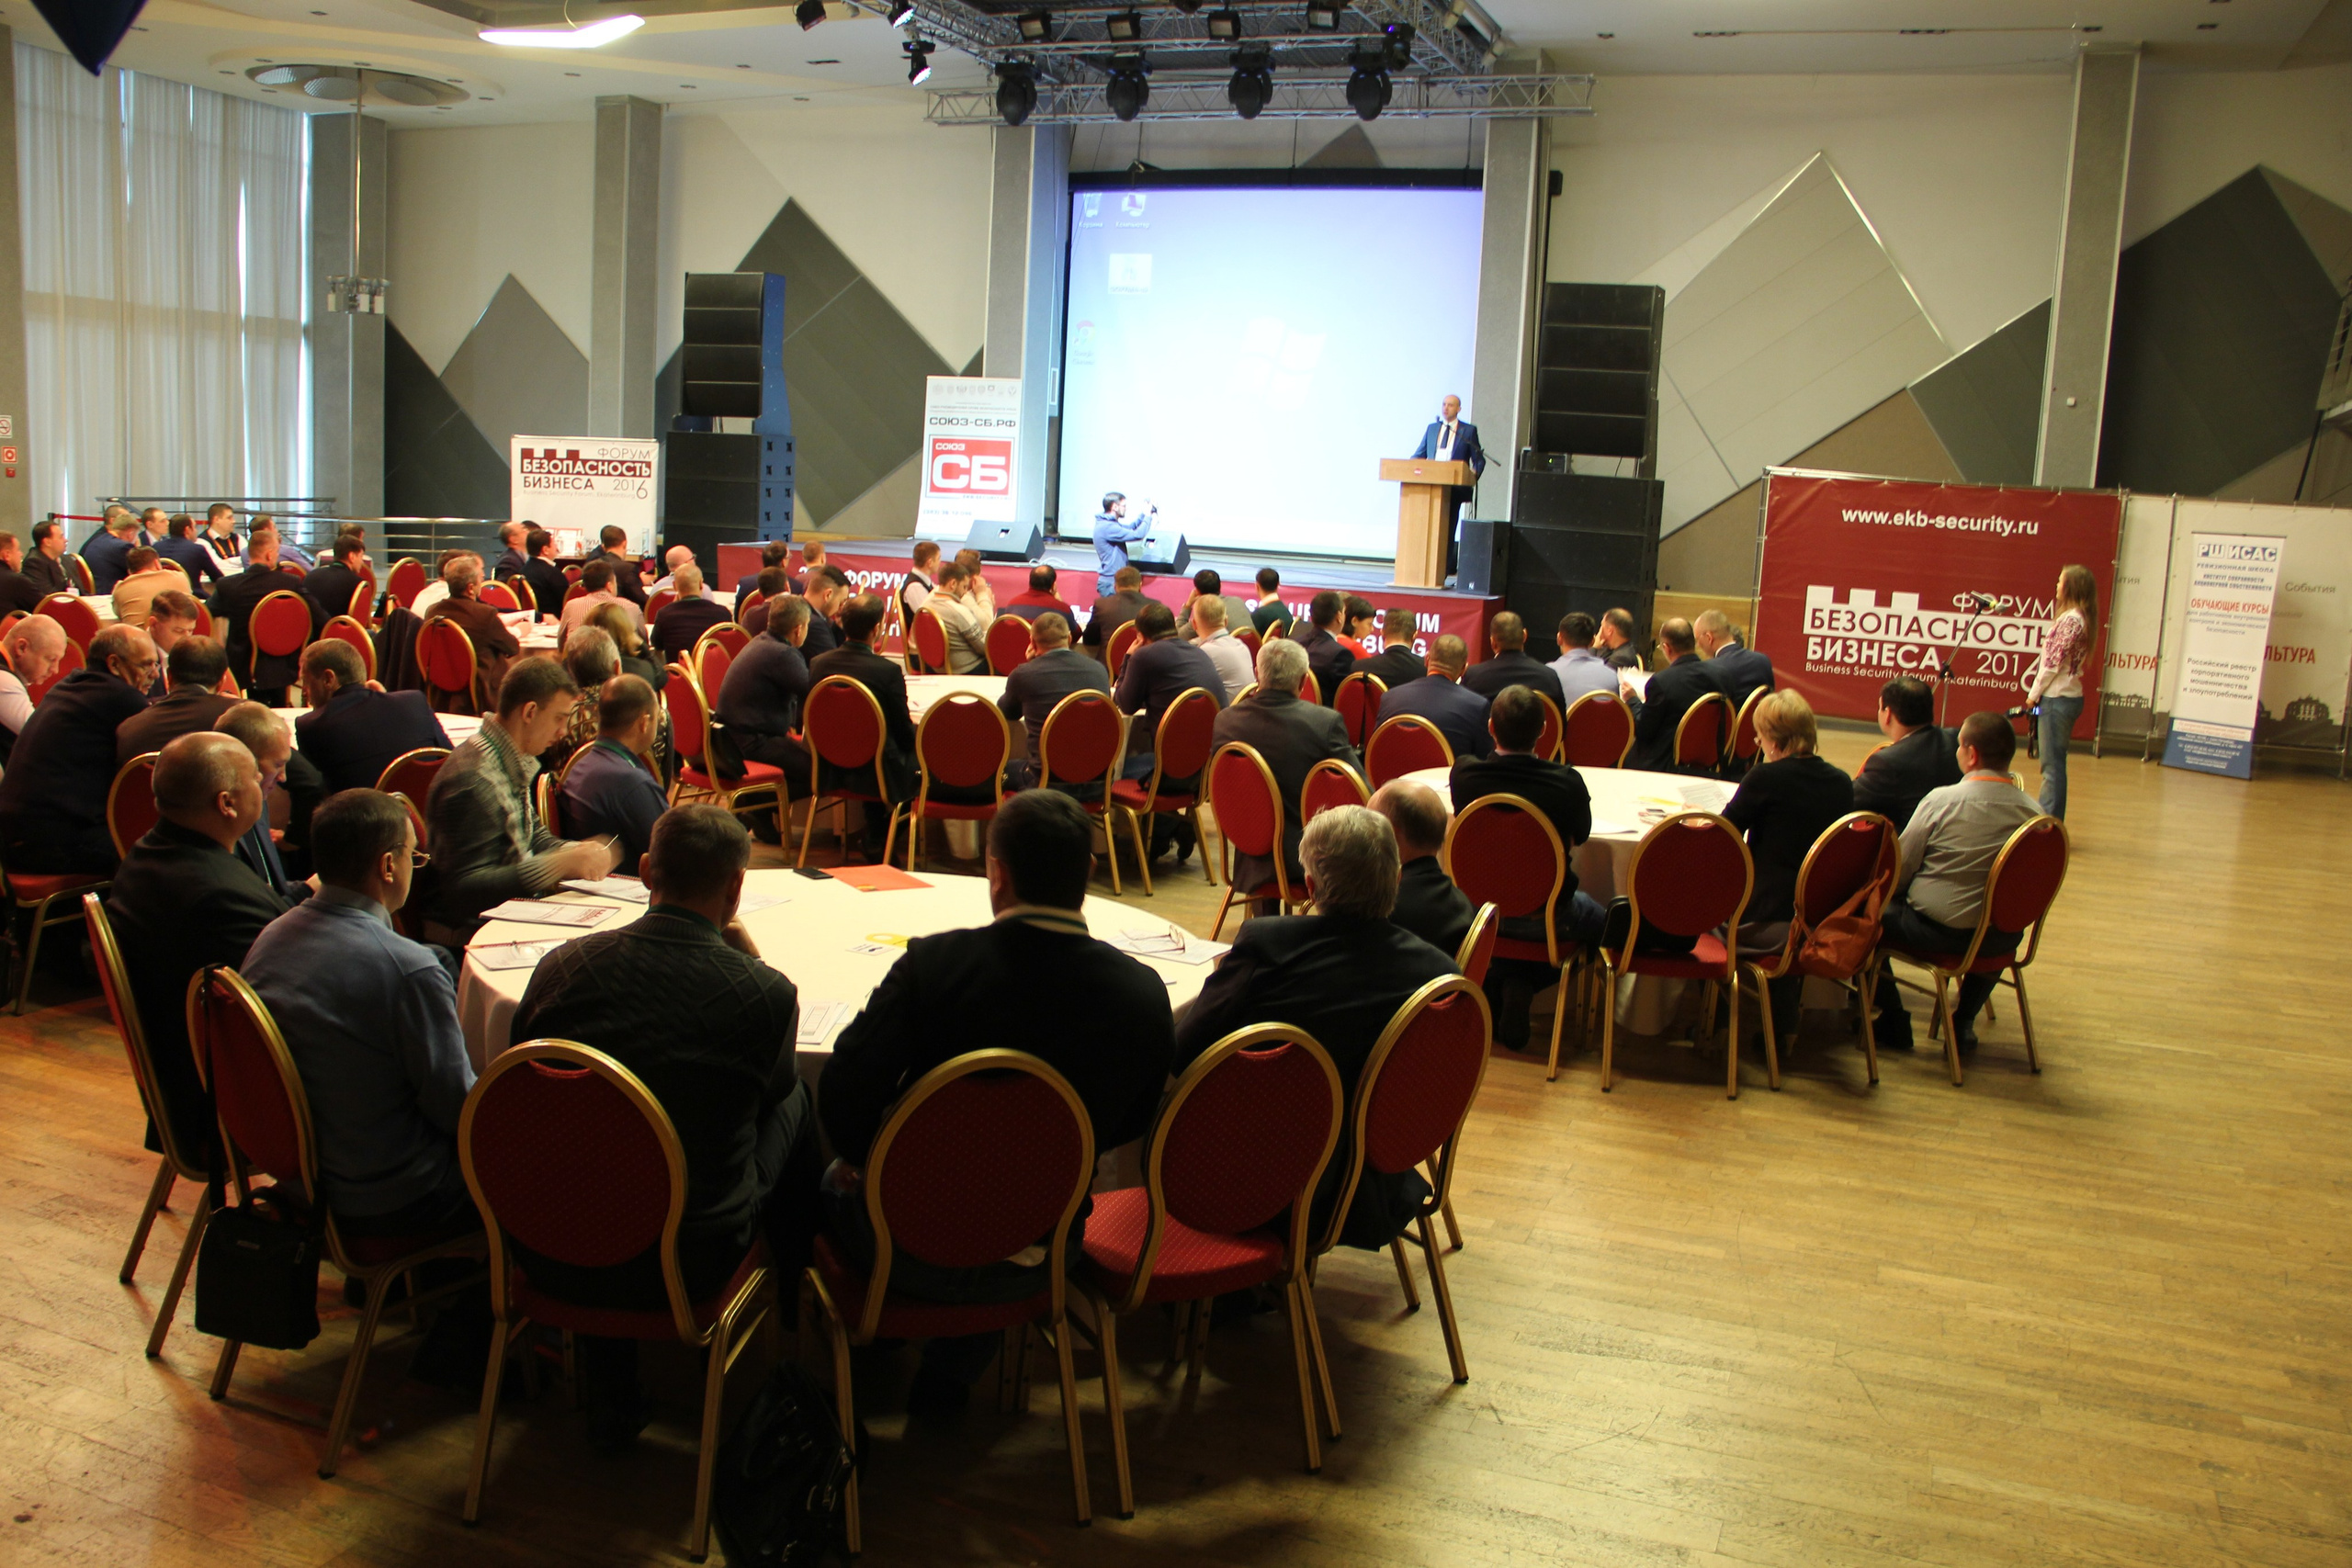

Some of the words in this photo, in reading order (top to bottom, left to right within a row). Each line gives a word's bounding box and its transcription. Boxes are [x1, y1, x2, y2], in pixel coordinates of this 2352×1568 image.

[929, 417, 1016, 427] СОЮЗ-СБ.РФ
[597, 447, 650, 459] ФОРУМ
[935, 443, 966, 451] СОЮЗ
[523, 458, 650, 477] БЕЗОПАСНОСТЬ
[933, 454, 1008, 491] СБ
[524, 476, 594, 491] БИЗНЕСА
[613, 478, 648, 500] 2016
[1842, 508, 2039, 536] www.ekb-security.ru
[2199, 544, 2224, 558] РШ
[2227, 545, 2278, 562] ИСАС
[2247, 565, 2274, 573] ШКОЛА
[2284, 581, 2336, 594] События
[2190, 598, 2241, 614] ОБУЧАЮЩИЕ
[2241, 603, 2269, 615] КУРСЫ
[1807, 636, 1941, 671] БИЗНЕСА
[2108, 652, 2157, 671] ЛЬТУРА
[2265, 645, 2316, 664] ЛЬТУРА
[1805, 661, 1850, 675] Business
[1852, 666, 1899, 681] Security
[2187, 657, 2230, 670] Российский
[2230, 663, 2257, 672] реестр
[2190, 669, 2250, 681] корпоративного
[2189, 678, 2248, 691] мошенничества
[2188, 687, 2254, 701] злоупотреблений
